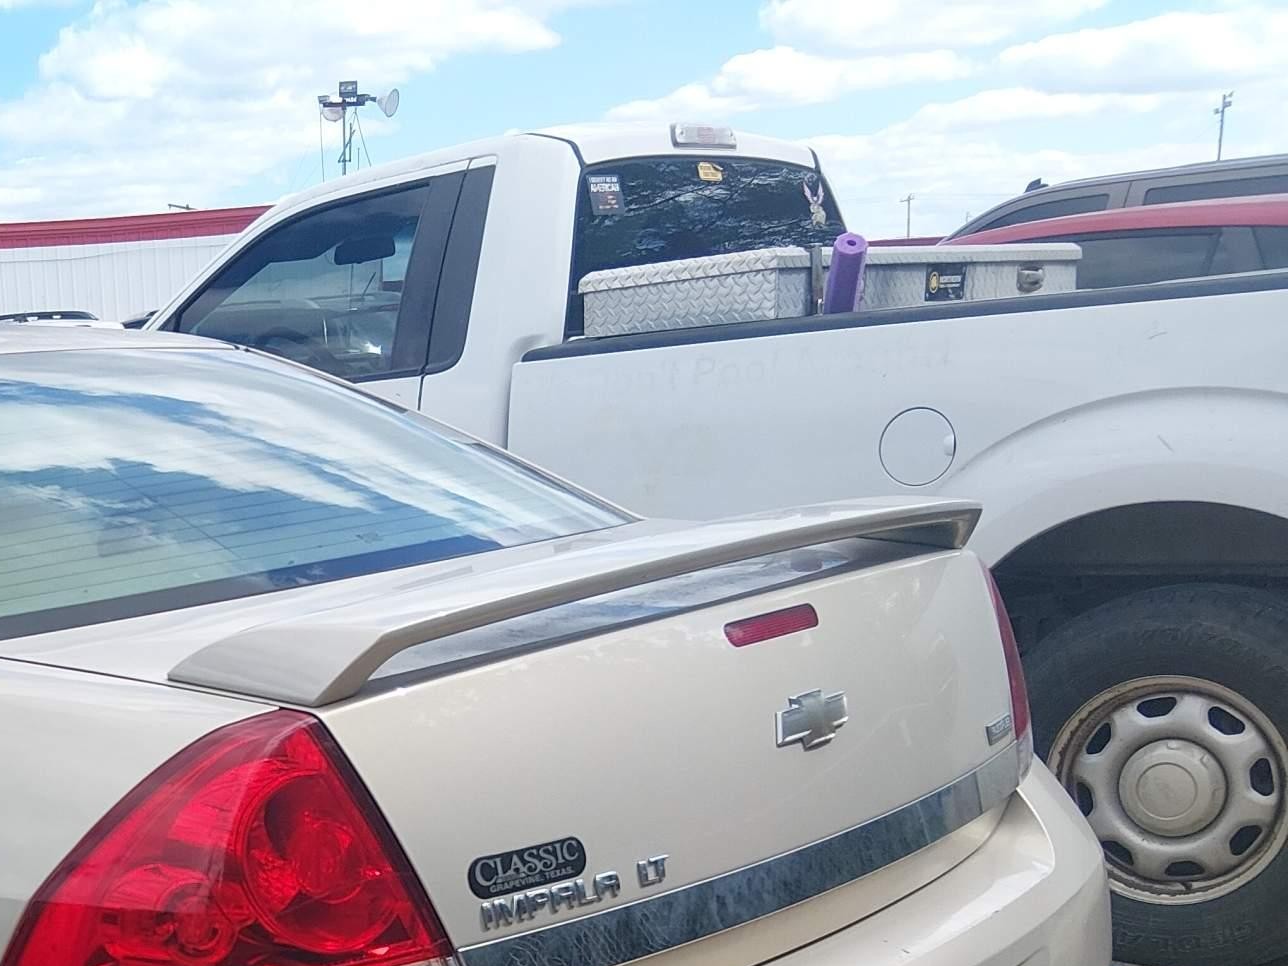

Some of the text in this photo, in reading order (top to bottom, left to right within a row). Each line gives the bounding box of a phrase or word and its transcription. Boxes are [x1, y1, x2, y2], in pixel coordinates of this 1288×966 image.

[475, 839, 579, 887] CLASSIC
[479, 854, 670, 932] IMPALA LT
